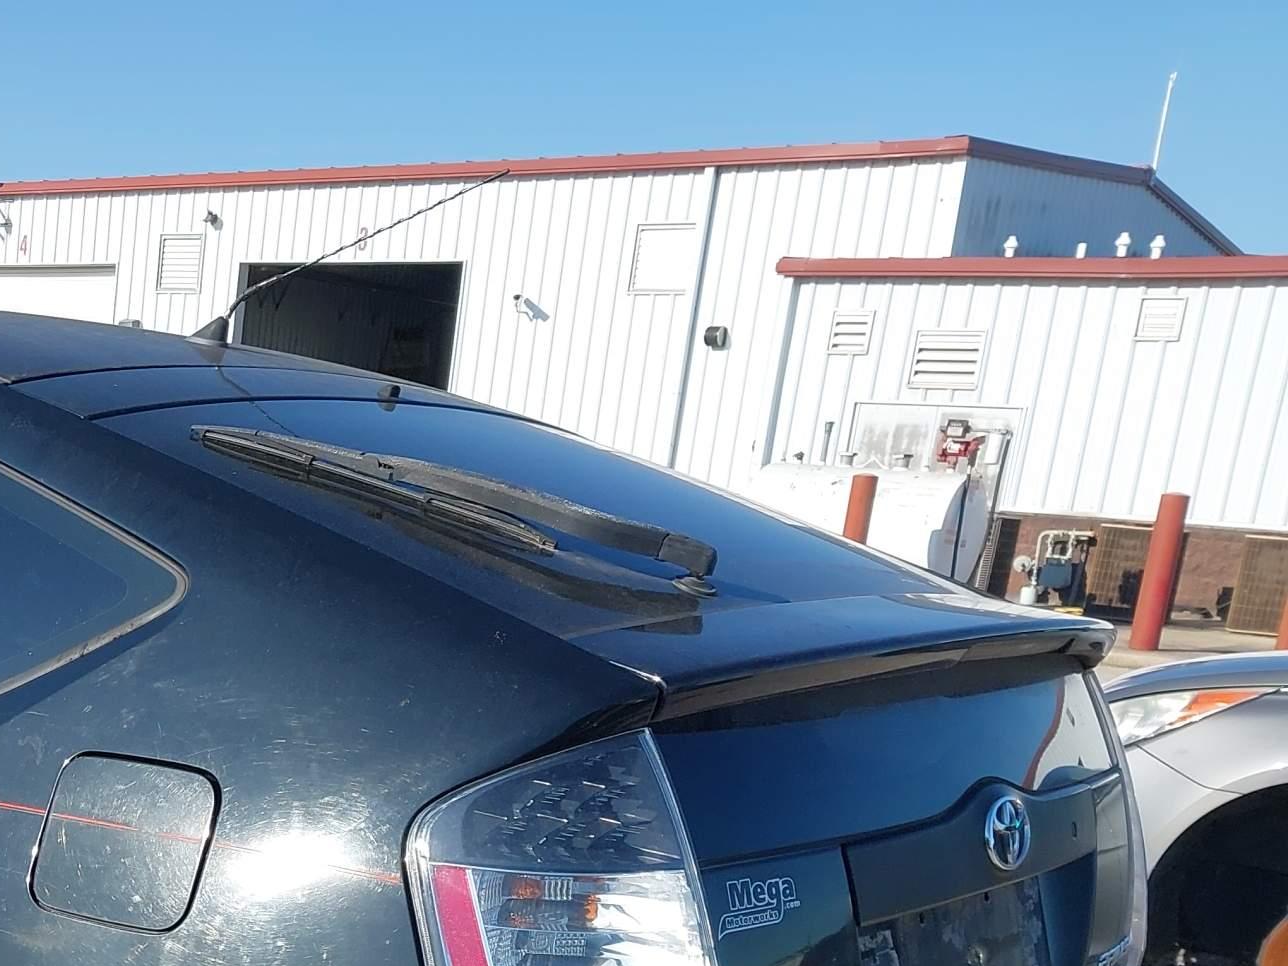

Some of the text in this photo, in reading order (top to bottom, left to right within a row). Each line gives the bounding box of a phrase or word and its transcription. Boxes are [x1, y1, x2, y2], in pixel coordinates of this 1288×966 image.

[19, 234, 28, 257] 4
[358, 226, 369, 251] 3
[726, 877, 796, 911] Mega
[725, 910, 780, 929] Motorworks
